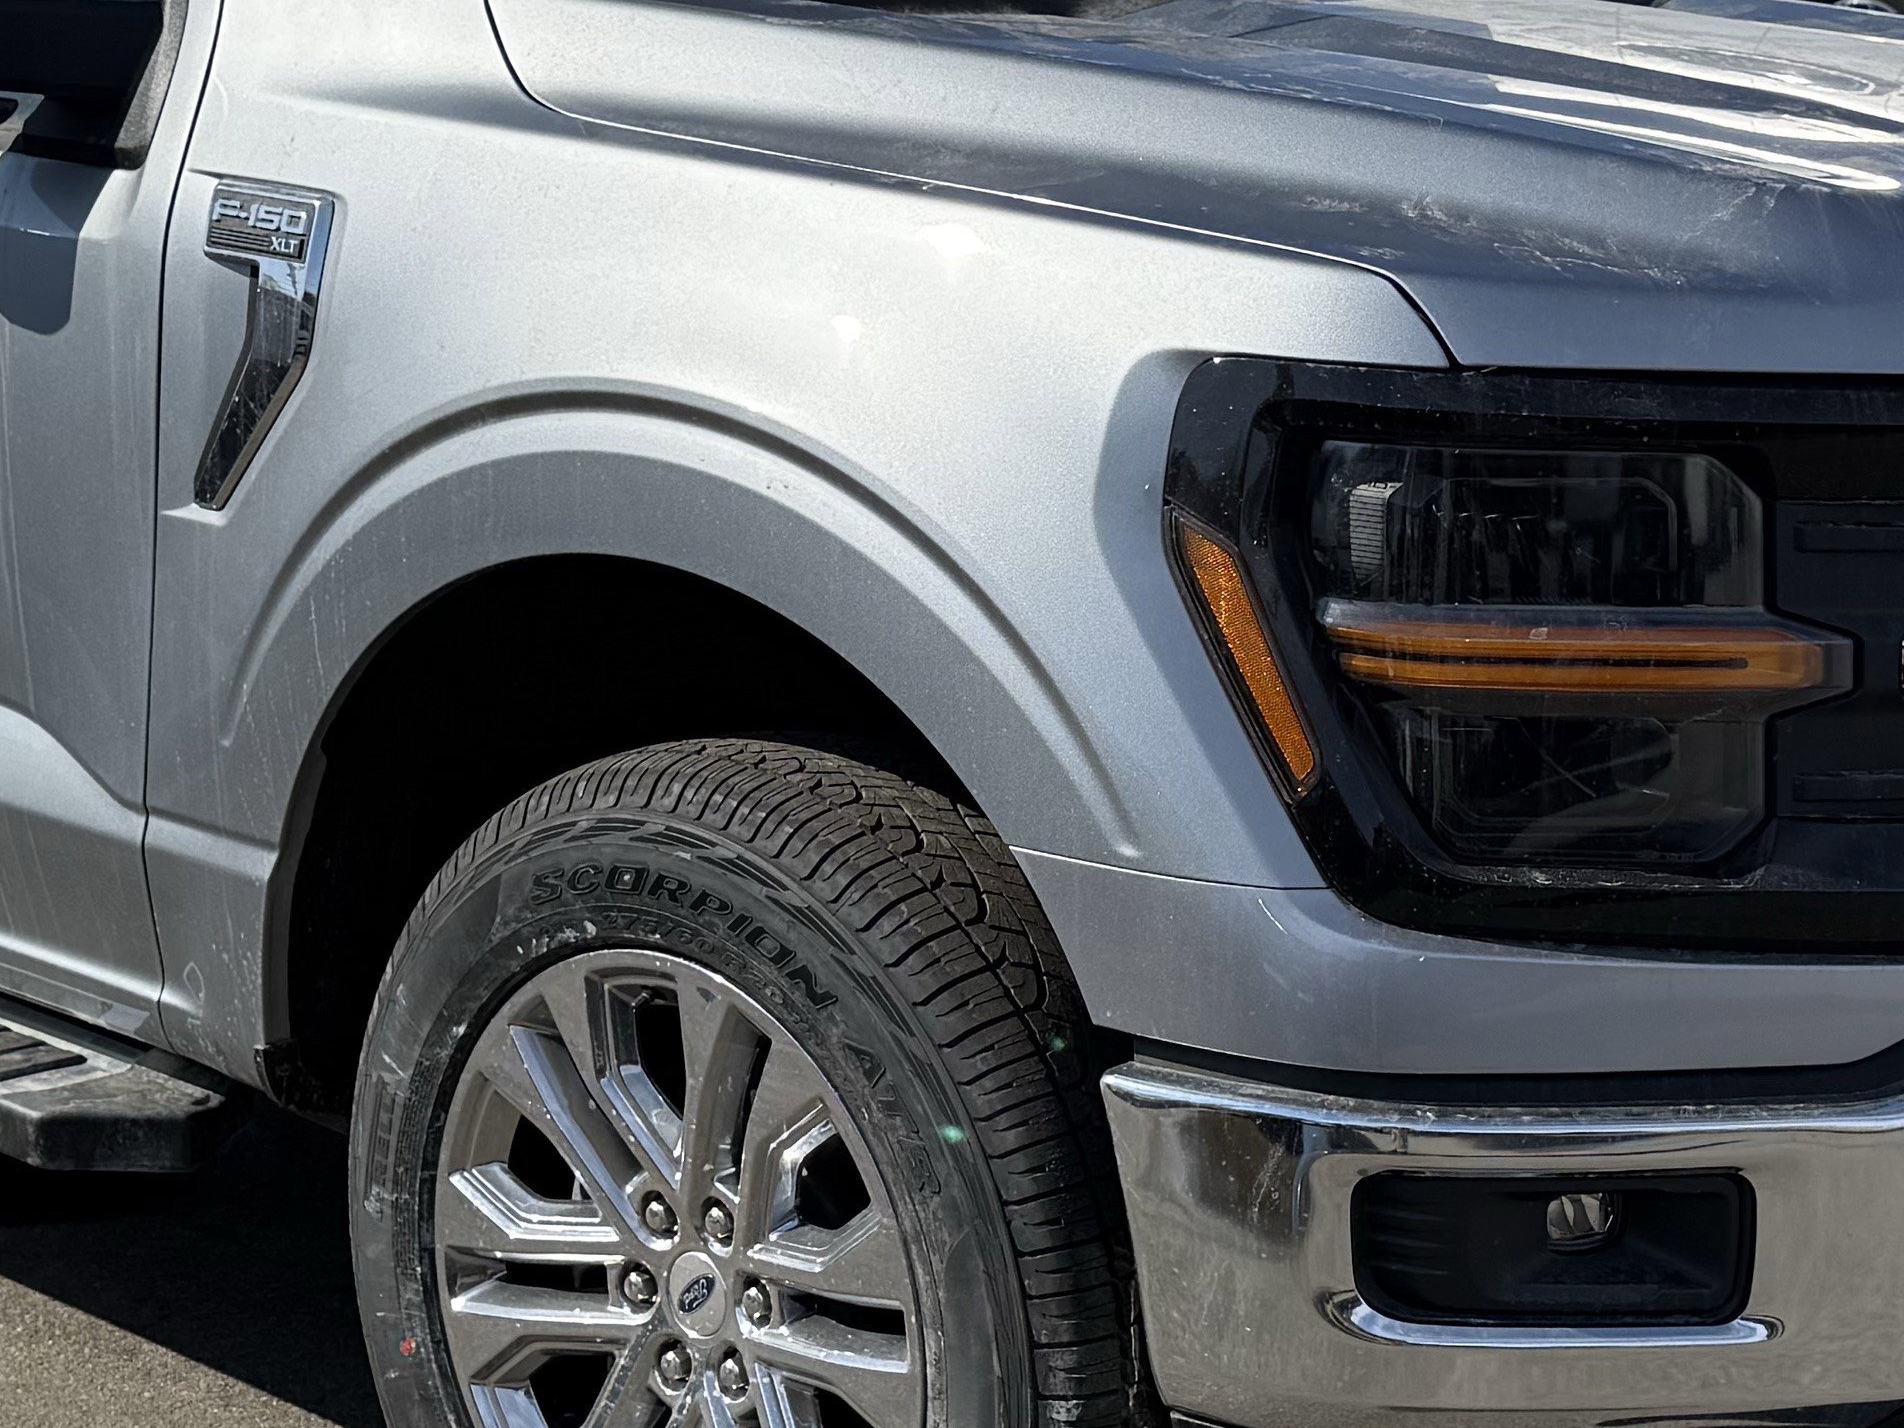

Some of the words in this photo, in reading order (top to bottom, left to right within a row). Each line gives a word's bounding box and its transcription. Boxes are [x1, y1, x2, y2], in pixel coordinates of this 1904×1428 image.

[212, 198, 307, 234] F-150
[270, 236, 298, 253] XLT
[530, 862, 839, 1009] SCORPION
